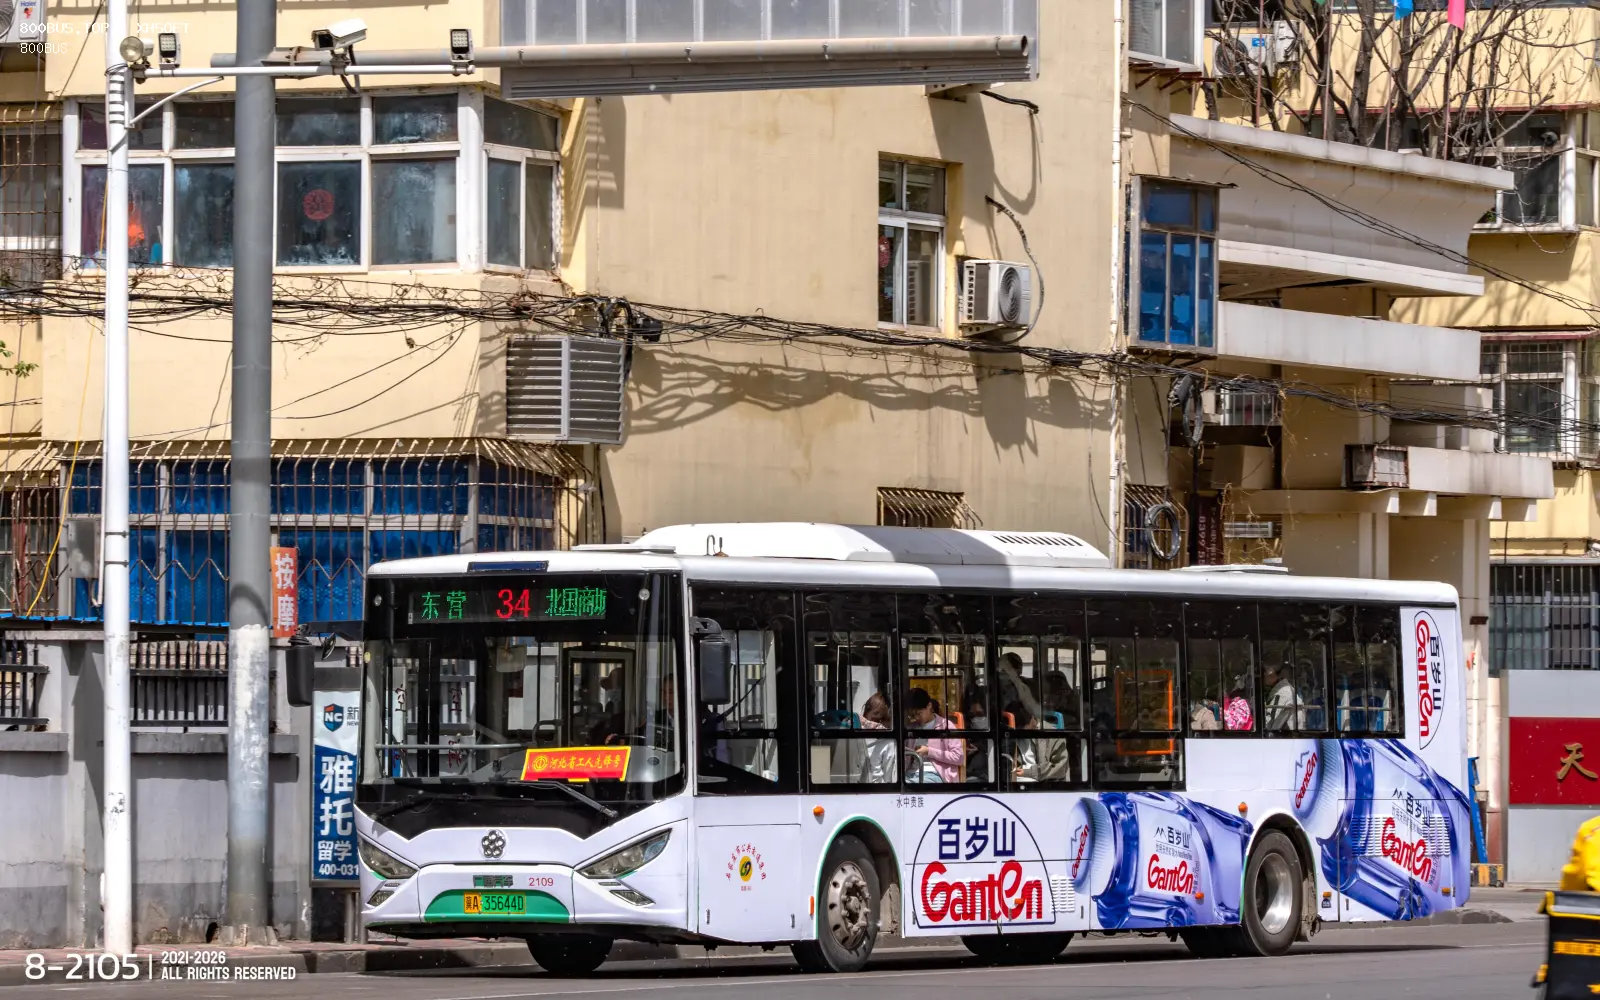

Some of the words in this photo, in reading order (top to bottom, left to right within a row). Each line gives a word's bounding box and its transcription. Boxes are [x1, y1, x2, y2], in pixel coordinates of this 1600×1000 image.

[275, 553, 294, 631] 按摩
[421, 590, 467, 620] 东营
[496, 588, 531, 619] 34
[1416, 620, 1433, 737] Ganten
[1430, 636, 1441, 710] 百岁山
[324, 711, 343, 722] NC
[550, 754, 621, 769] 河北省工人先锋号
[1556, 743, 1598, 780] 天
[320, 755, 354, 836] 雅托
[896, 796, 925, 808] 水中贵族
[318, 841, 352, 861] 留学
[938, 816, 1016, 861] 百岁山
[1167, 825, 1190, 849] 百岁山
[1381, 816, 1432, 883] Ganten
[528, 878, 554, 887] 2109
[921, 859, 1043, 923] Ganten
[1147, 853, 1194, 894] Ganten
